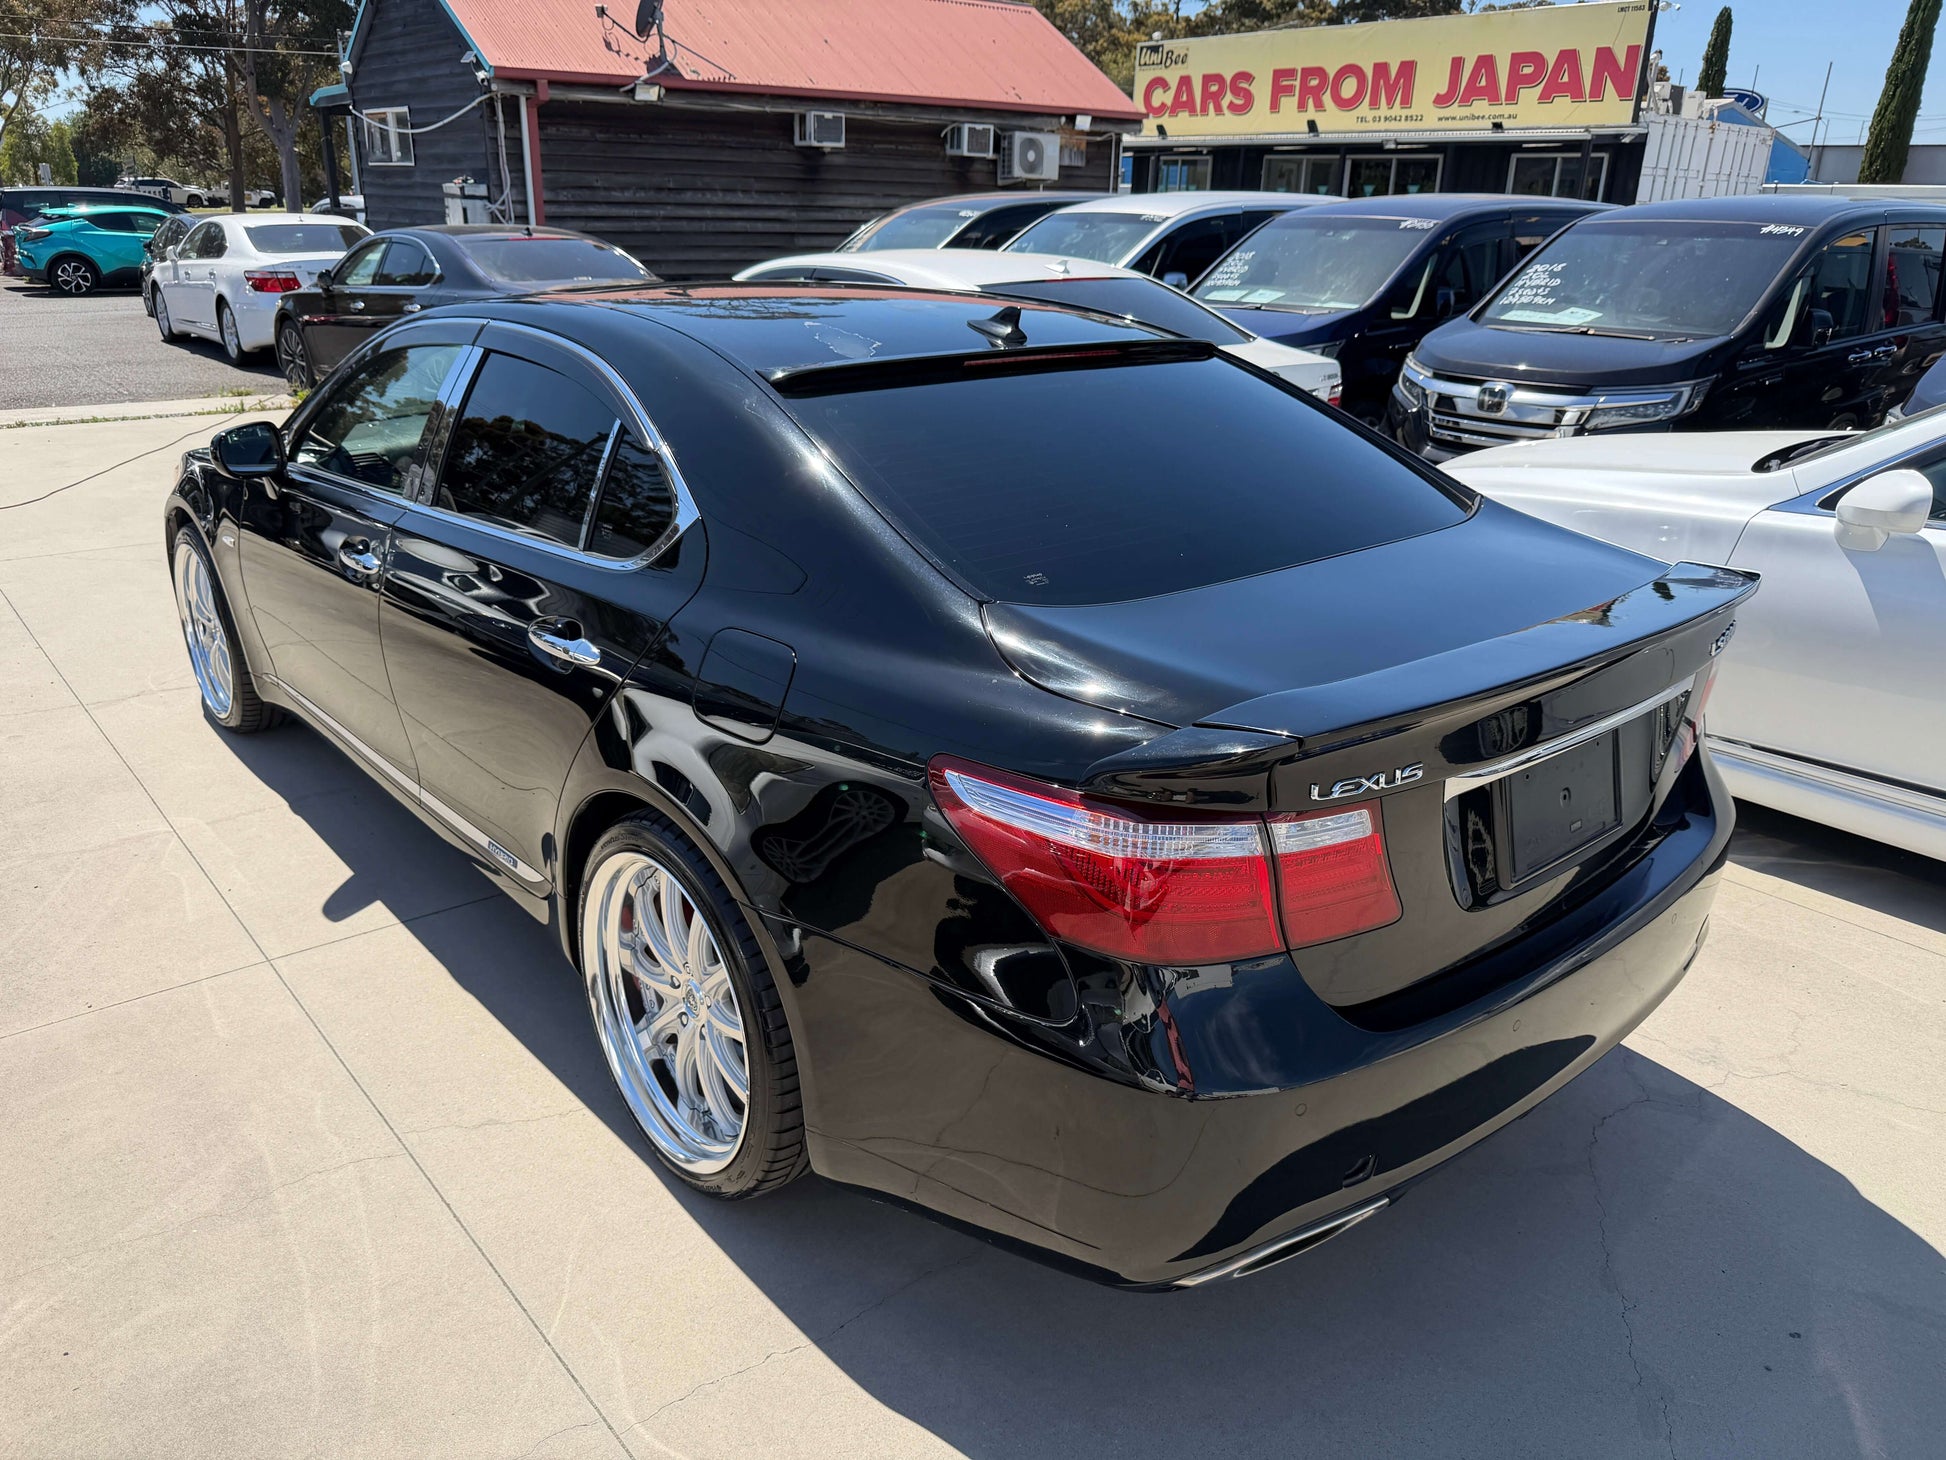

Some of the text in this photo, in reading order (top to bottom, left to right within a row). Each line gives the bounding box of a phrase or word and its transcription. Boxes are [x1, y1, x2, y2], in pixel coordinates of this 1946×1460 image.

[1164, 50, 1188, 69] Bee
[1143, 44, 1643, 118] CARS FROM JAPAN
[1437, 112, 1518, 122] www.unibee.com.au
[1310, 760, 1424, 800] LEXUS
